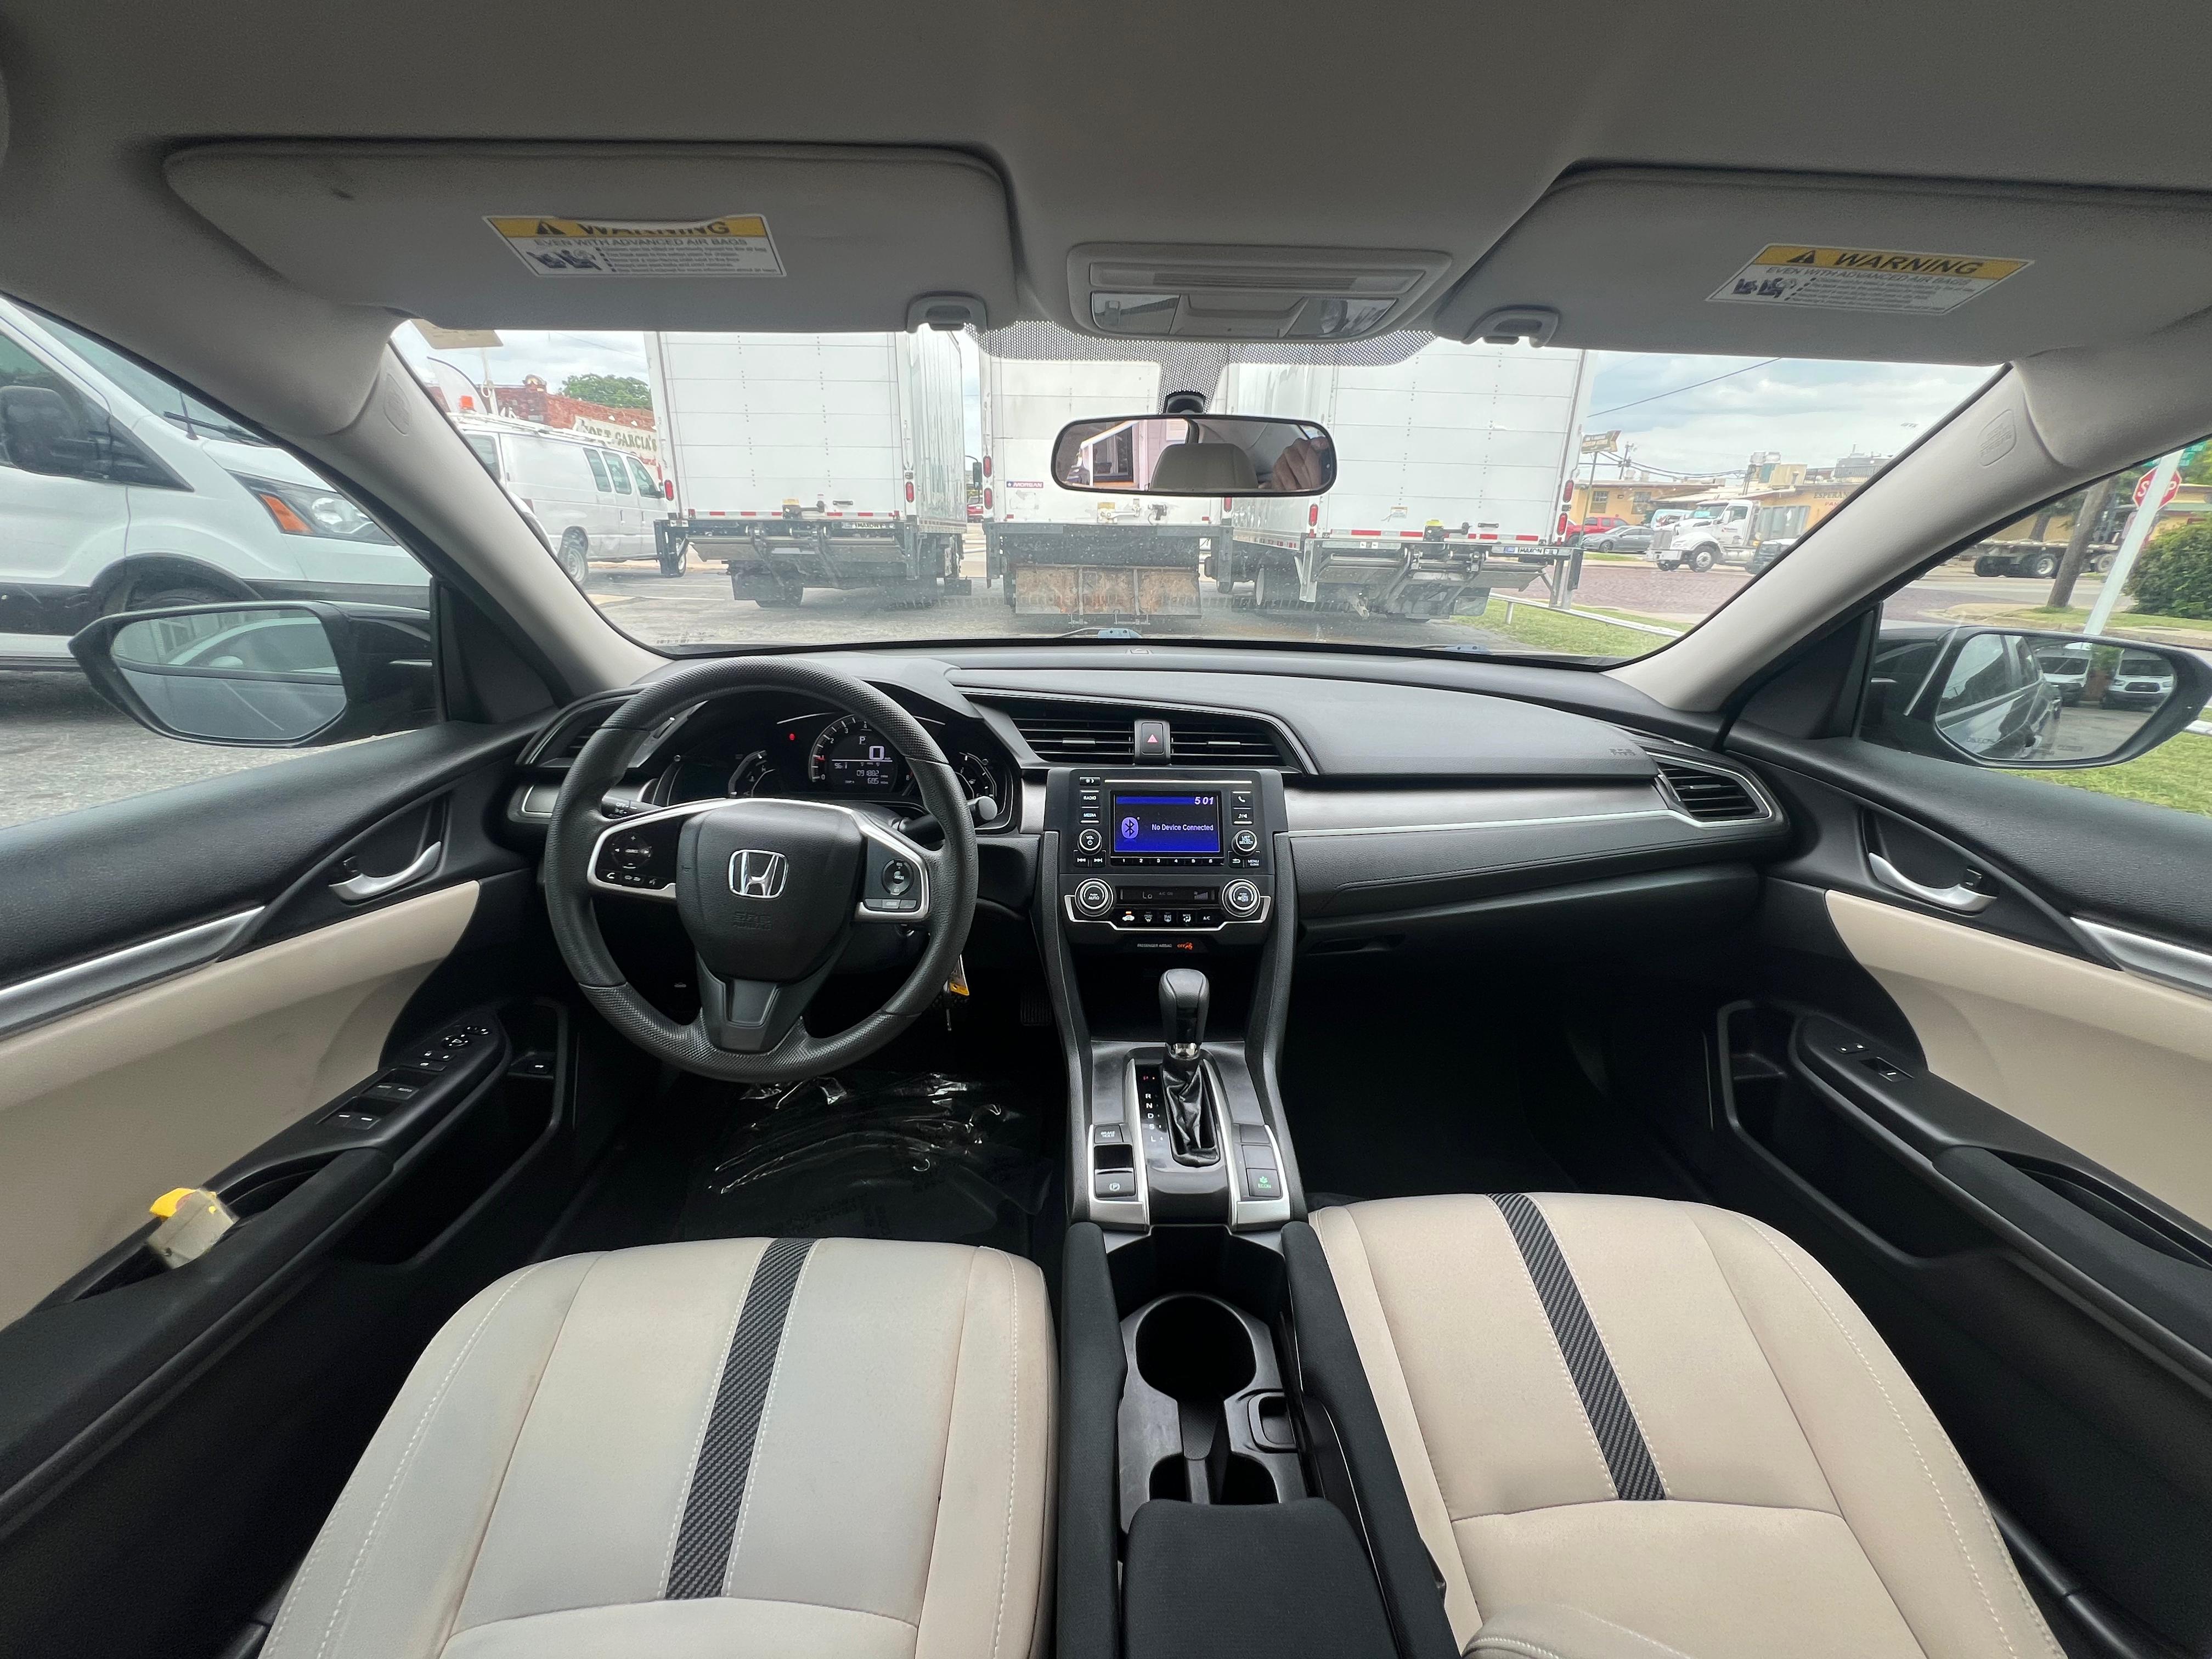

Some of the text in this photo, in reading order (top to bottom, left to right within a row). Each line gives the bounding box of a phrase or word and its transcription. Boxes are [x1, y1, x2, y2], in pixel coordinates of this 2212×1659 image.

[1834, 253, 1983, 274] WARNING
[2137, 480, 2177, 497] SP
[859, 736, 866, 745] P
[869, 746, 885, 760] 0
